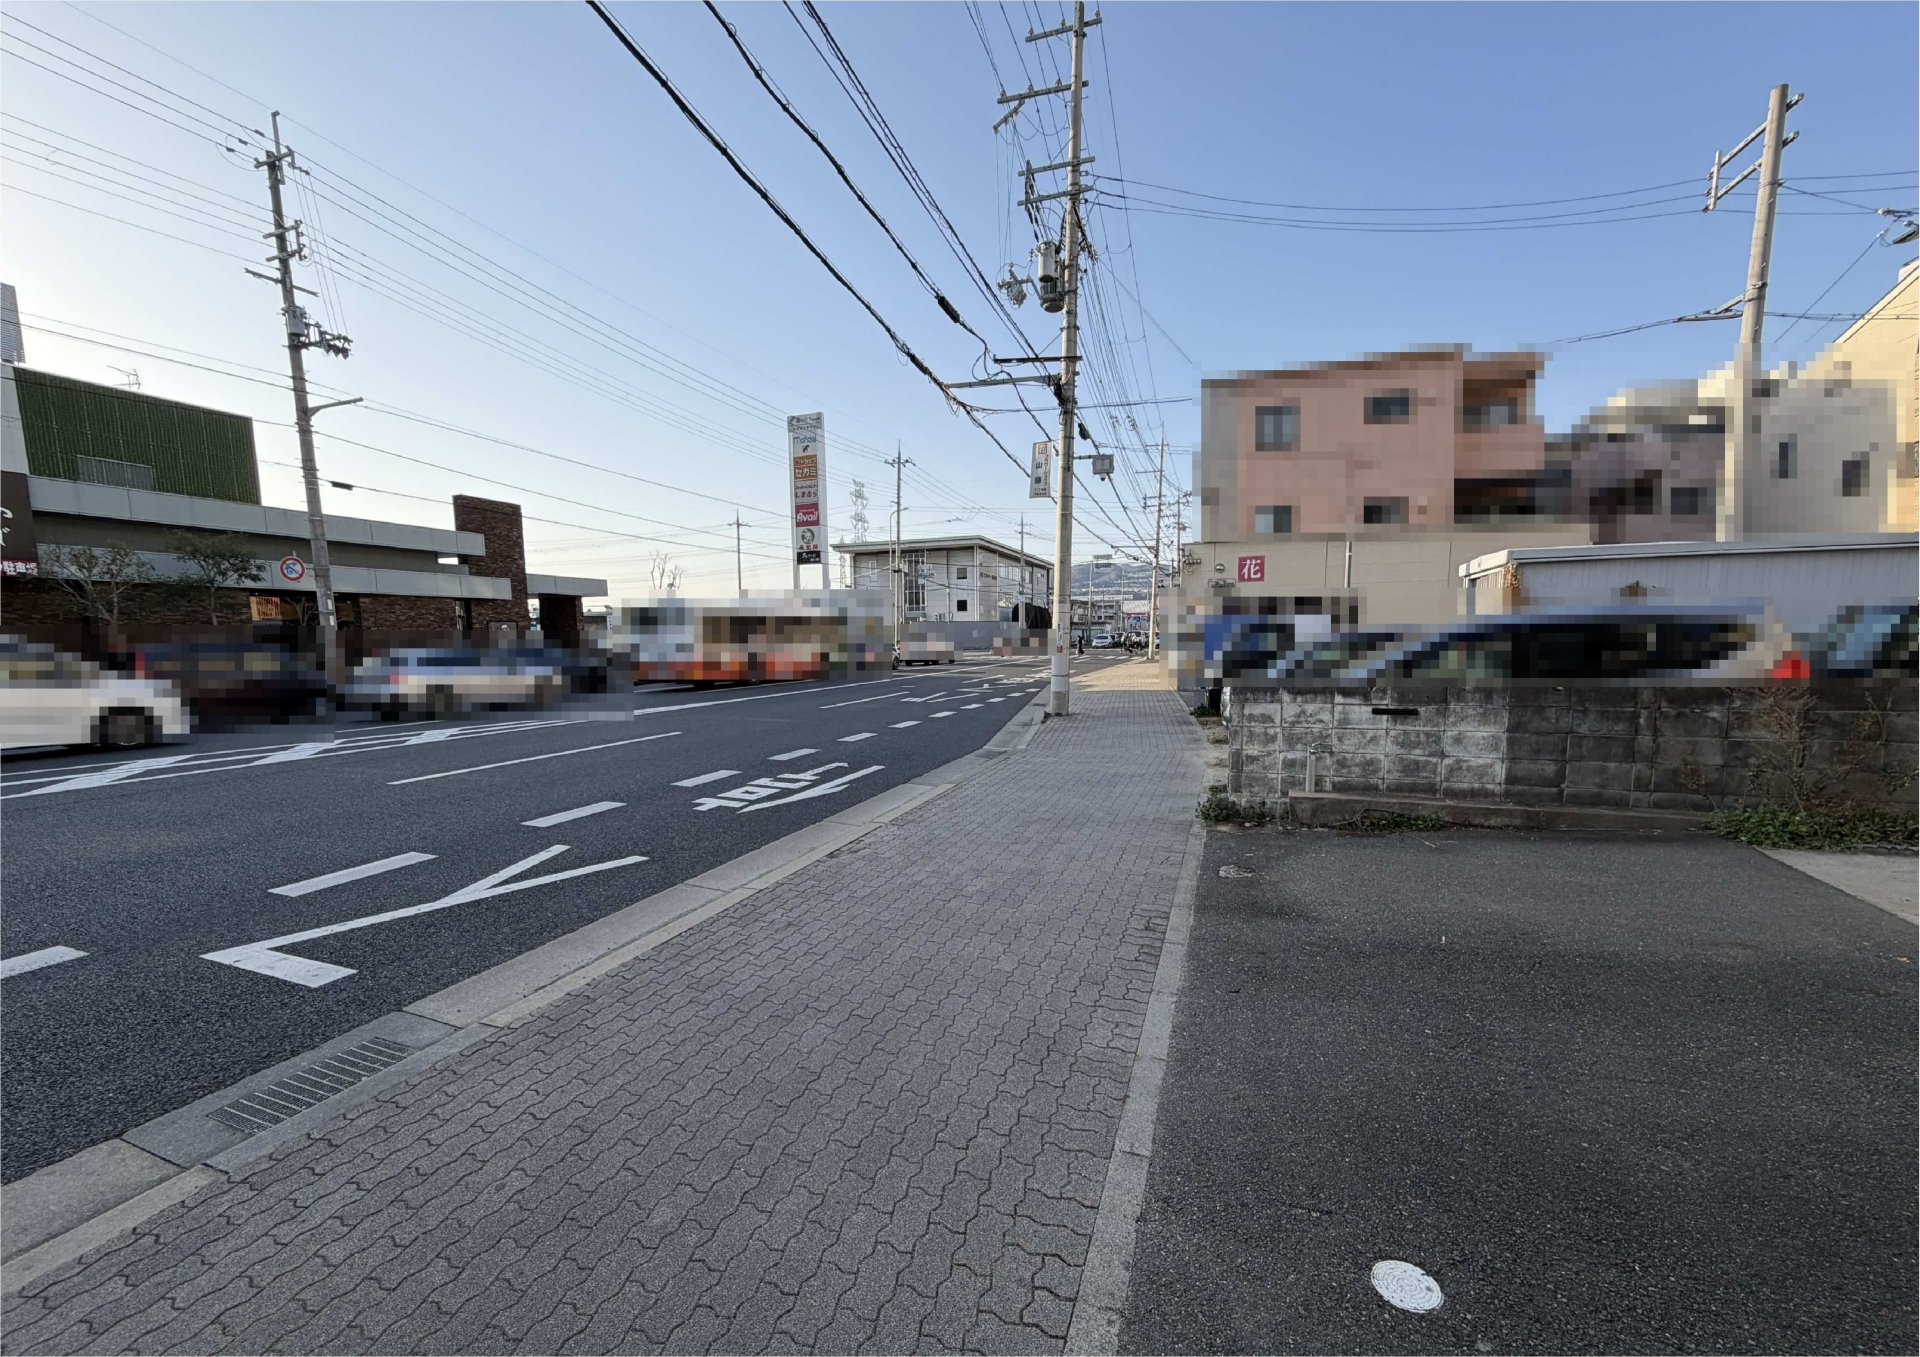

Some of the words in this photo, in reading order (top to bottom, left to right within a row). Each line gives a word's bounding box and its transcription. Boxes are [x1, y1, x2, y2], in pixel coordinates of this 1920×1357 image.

[795, 467, 817, 477] セガミ
[796, 511, 818, 522] Avail
[1240, 559, 1262, 579] 花
